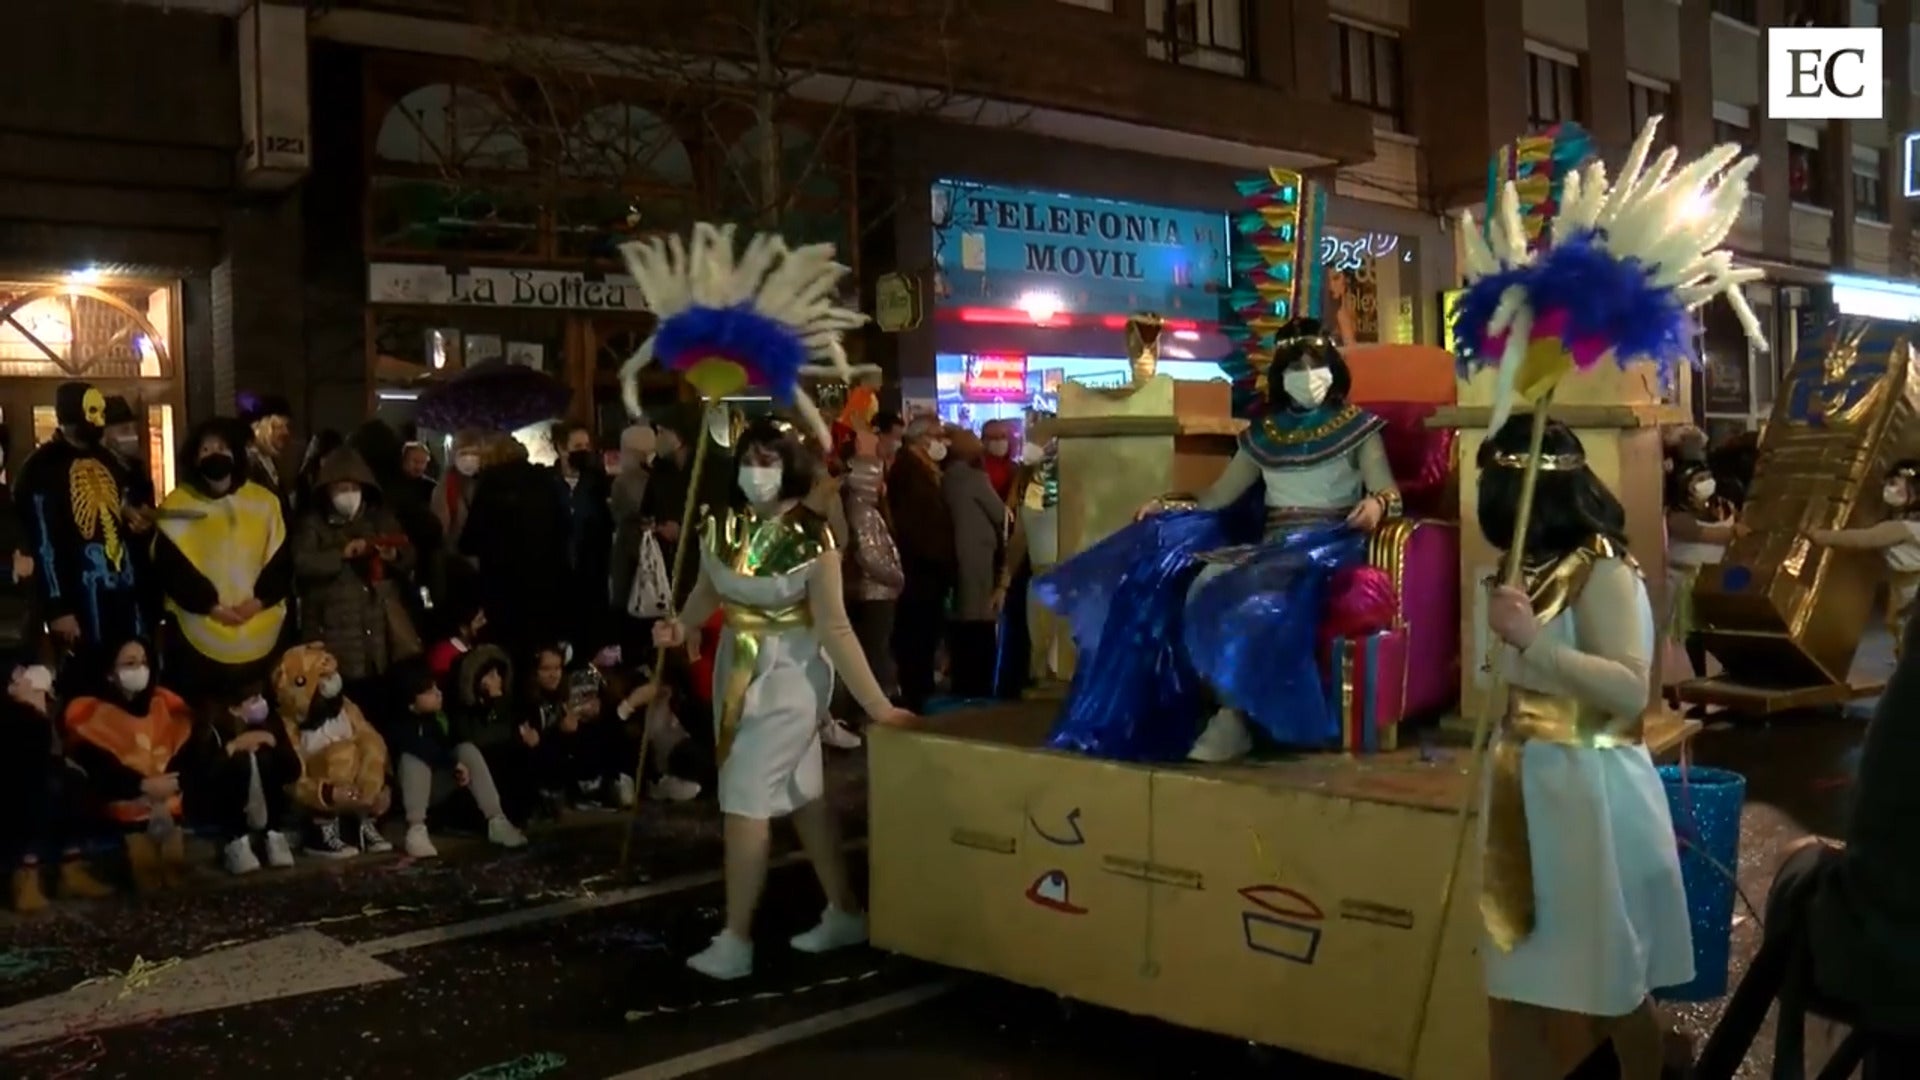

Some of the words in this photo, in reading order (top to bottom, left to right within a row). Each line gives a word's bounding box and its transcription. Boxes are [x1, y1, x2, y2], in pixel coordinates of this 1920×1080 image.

[265, 135, 304, 154] 123
[968, 197, 1184, 247] TELEFONIA
[1025, 242, 1145, 280] MOVIL
[450, 270, 496, 303] La
